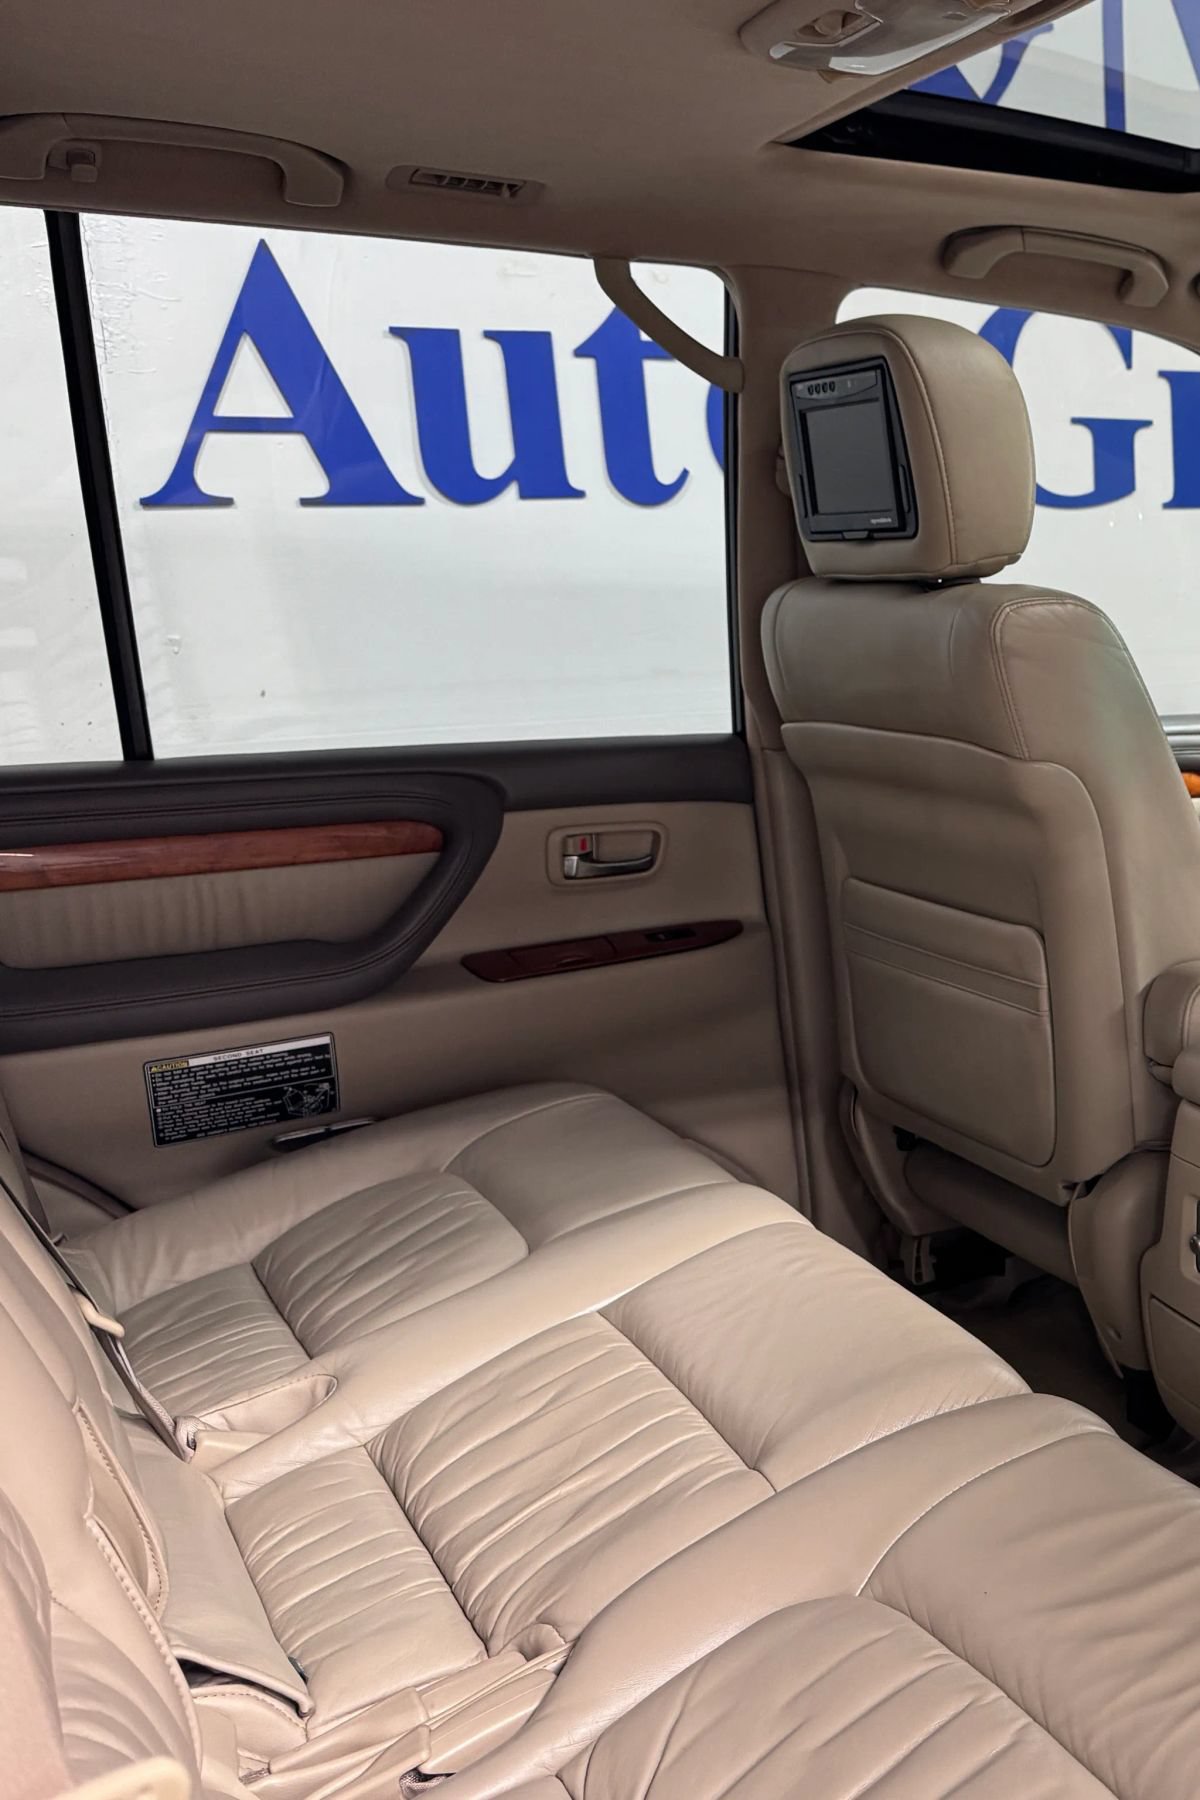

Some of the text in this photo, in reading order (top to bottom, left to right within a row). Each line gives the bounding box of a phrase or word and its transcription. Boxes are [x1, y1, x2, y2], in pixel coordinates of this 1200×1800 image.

[140, 238, 724, 507] Aut
[213, 1052, 243, 1062] SECOND
[246, 1048, 265, 1057] SEAT
